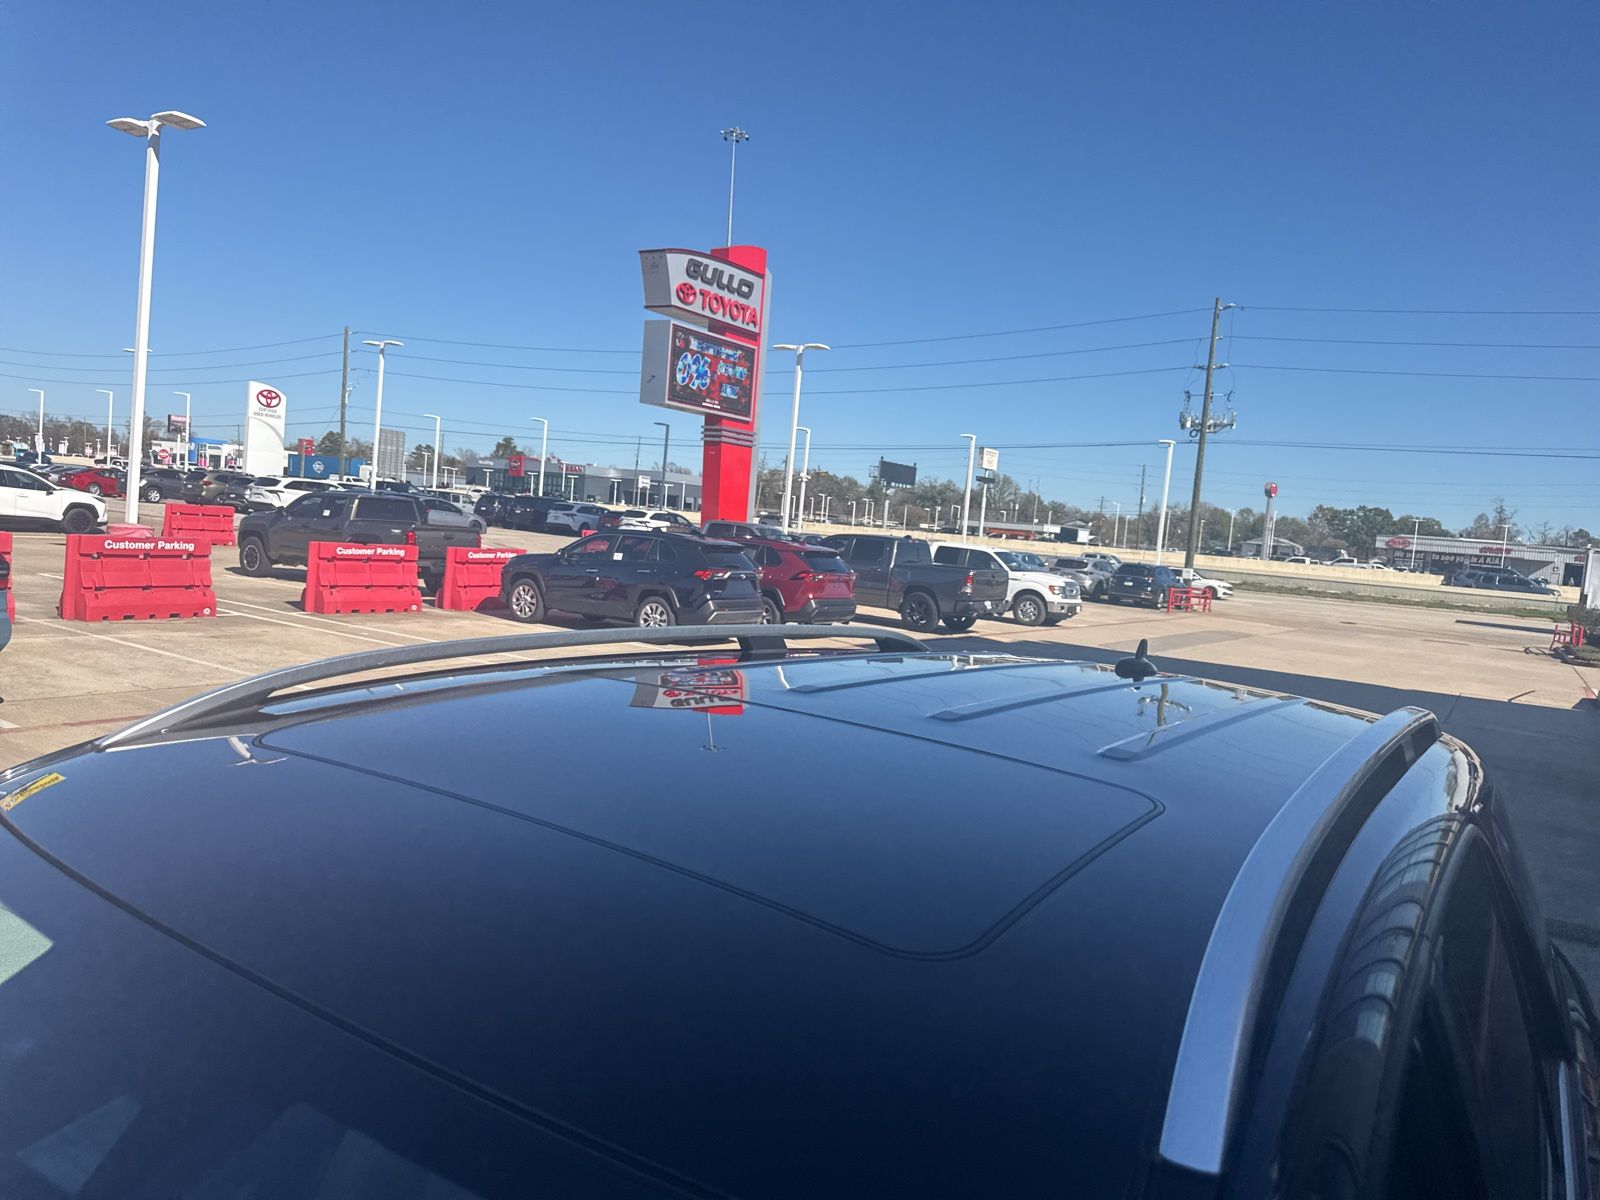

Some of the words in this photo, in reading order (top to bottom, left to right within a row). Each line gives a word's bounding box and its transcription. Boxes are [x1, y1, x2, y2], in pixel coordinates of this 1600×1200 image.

[685, 257, 754, 300] GULLO
[699, 288, 758, 328] TOYOTA
[104, 540, 155, 549] Customer
[157, 540, 195, 552] Parking
[336, 546, 375, 555] Customer
[376, 547, 405, 557] Parking
[468, 551, 496, 559] Customer
